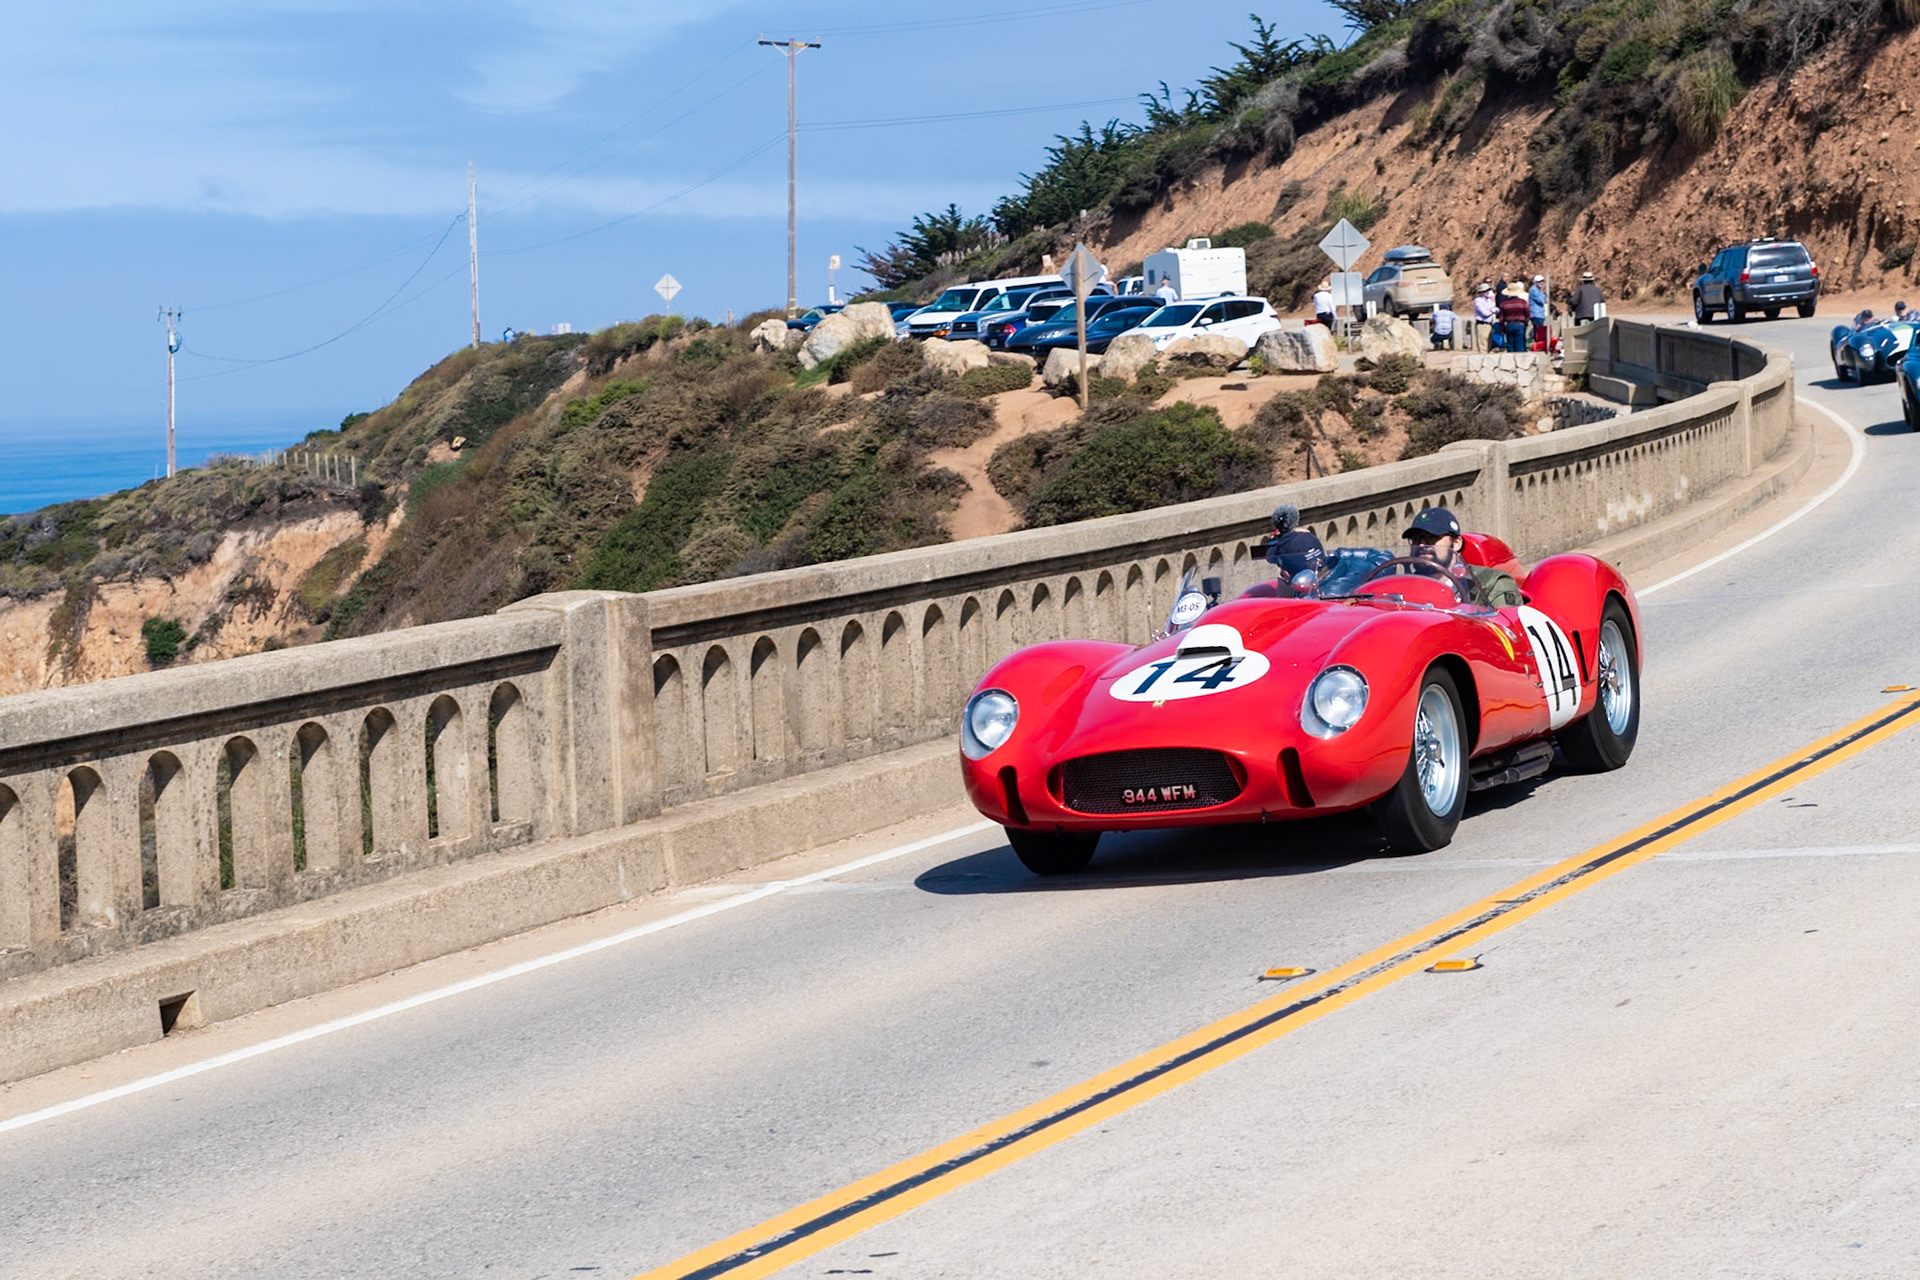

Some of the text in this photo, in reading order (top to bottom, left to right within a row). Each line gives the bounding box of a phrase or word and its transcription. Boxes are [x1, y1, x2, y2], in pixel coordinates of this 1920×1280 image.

[1132, 656, 1246, 695] 14
[1527, 621, 1577, 711] 14
[1123, 784, 1196, 804] 944 WFM
